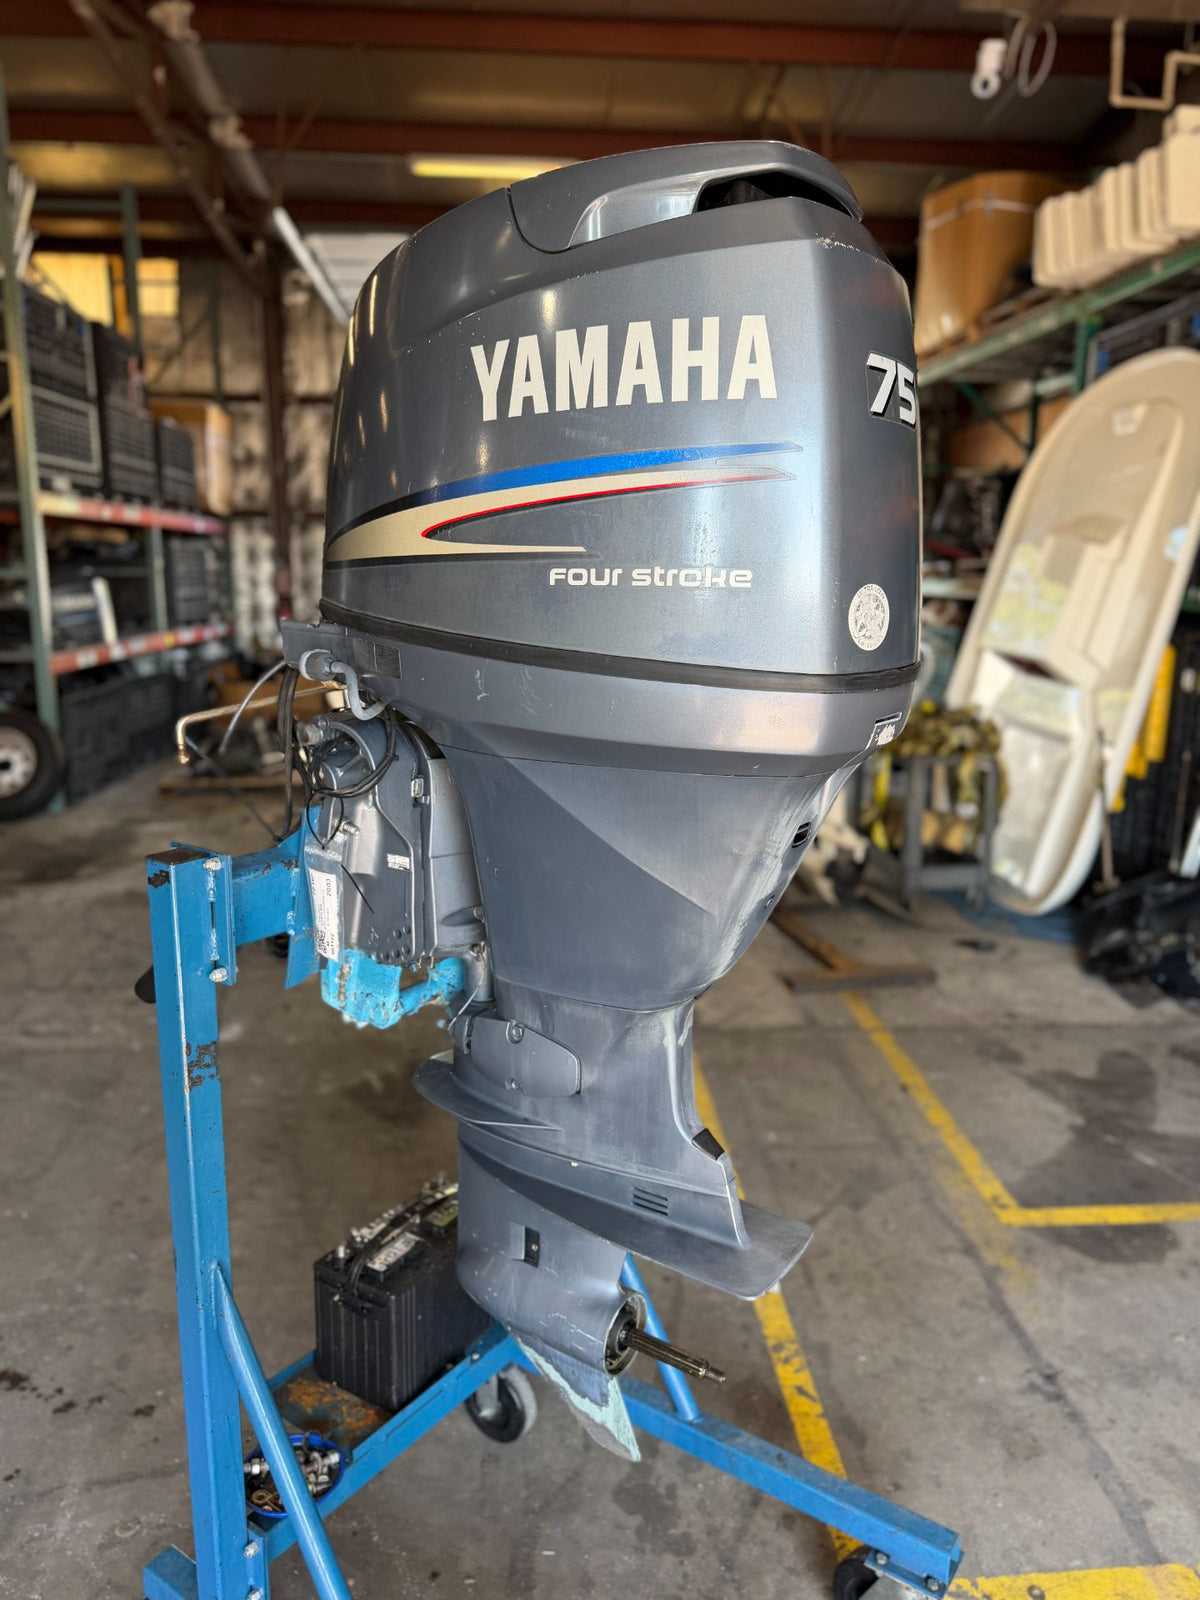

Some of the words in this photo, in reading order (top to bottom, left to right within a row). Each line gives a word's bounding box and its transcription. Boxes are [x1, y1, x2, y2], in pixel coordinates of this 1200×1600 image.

[470, 315, 777, 422] YAMAHA
[866, 352, 916, 426] 75
[631, 566, 753, 588] stroke
